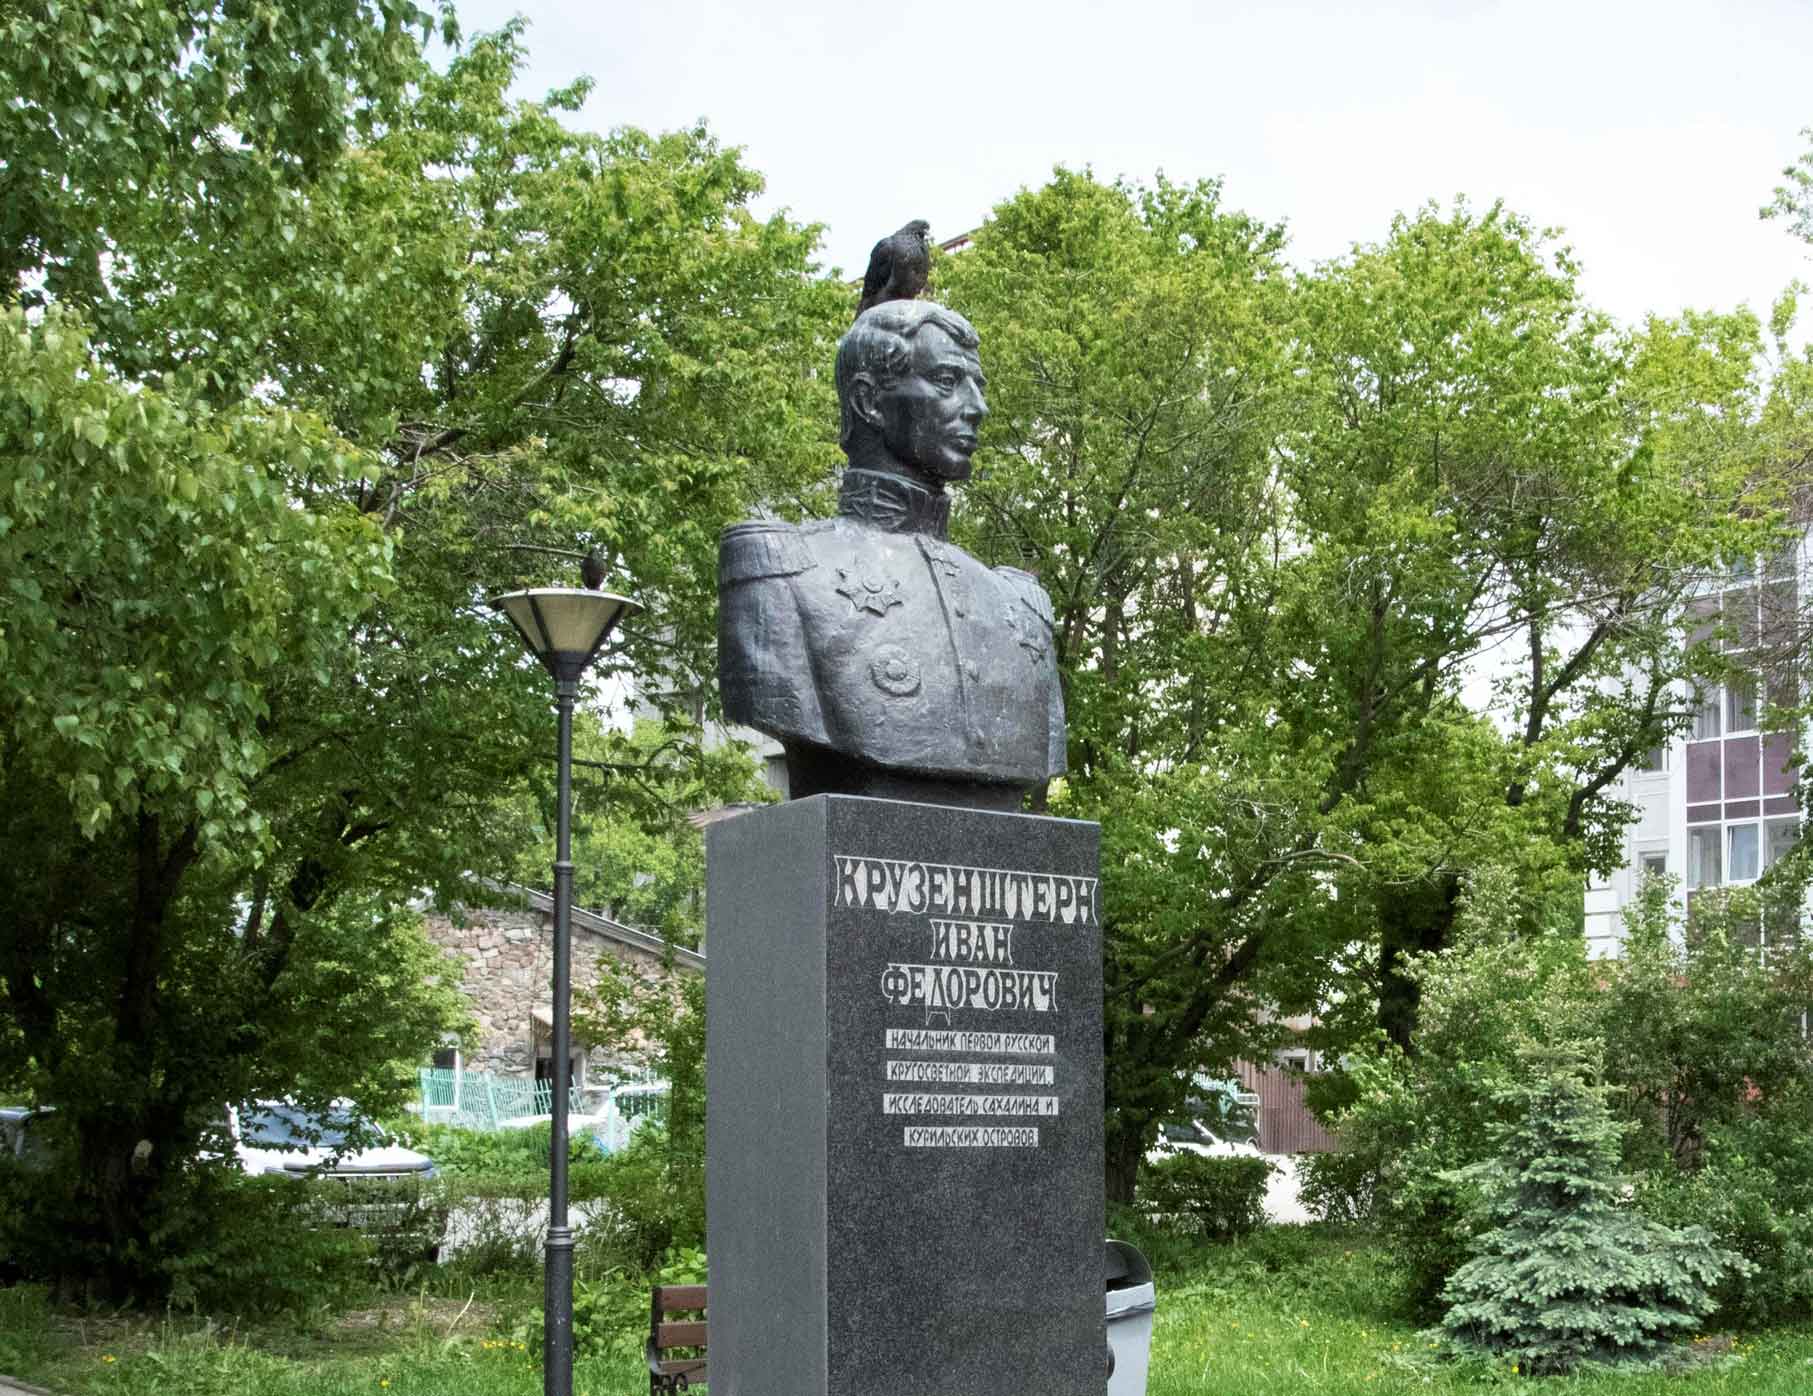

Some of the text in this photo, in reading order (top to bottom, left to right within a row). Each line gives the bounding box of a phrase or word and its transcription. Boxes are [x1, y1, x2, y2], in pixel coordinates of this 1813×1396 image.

[834, 855, 1097, 926] КРУЗЕНШТЕРН
[930, 919, 1013, 965] ИВАН
[882, 963, 1057, 1026] ФЕДОРОВИЧ
[890, 1030, 956, 1050] НАЧАЛЬНИК
[888, 1094, 1054, 1115] ИССЛЕДОВАТЕЛЬ САХАЛИНА И
[909, 1128, 979, 1147] КУРИЛЬСКИХ
